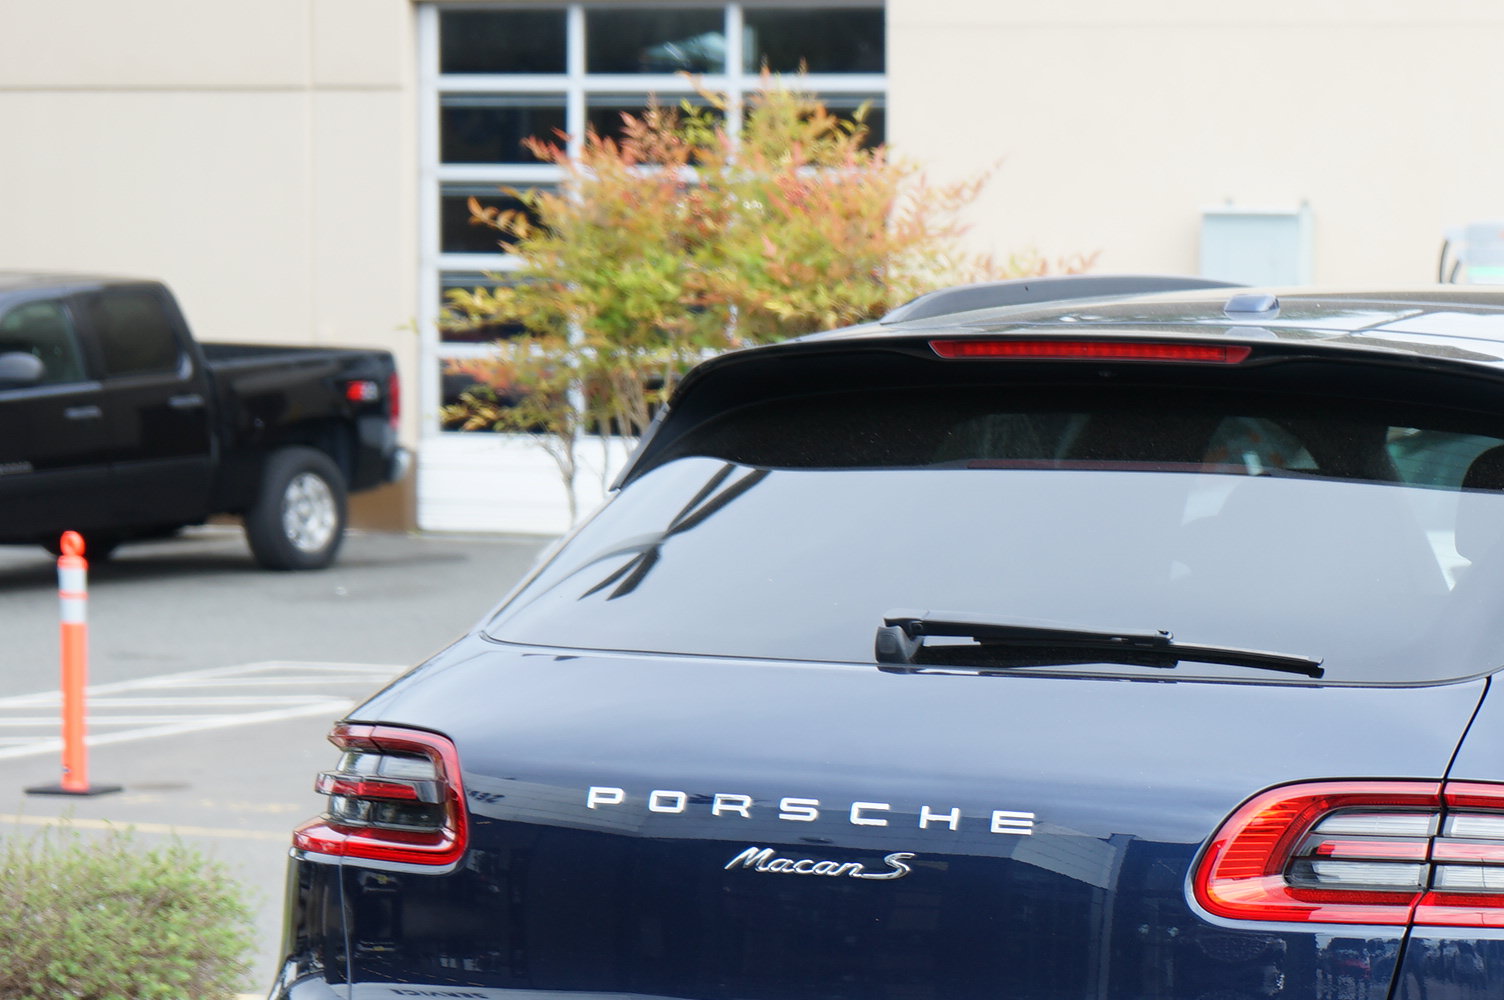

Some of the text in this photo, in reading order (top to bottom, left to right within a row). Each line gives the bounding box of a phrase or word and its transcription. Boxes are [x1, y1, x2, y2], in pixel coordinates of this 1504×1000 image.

[586, 786, 1036, 836] PORSCHE
[724, 846, 916, 880] Macan S
